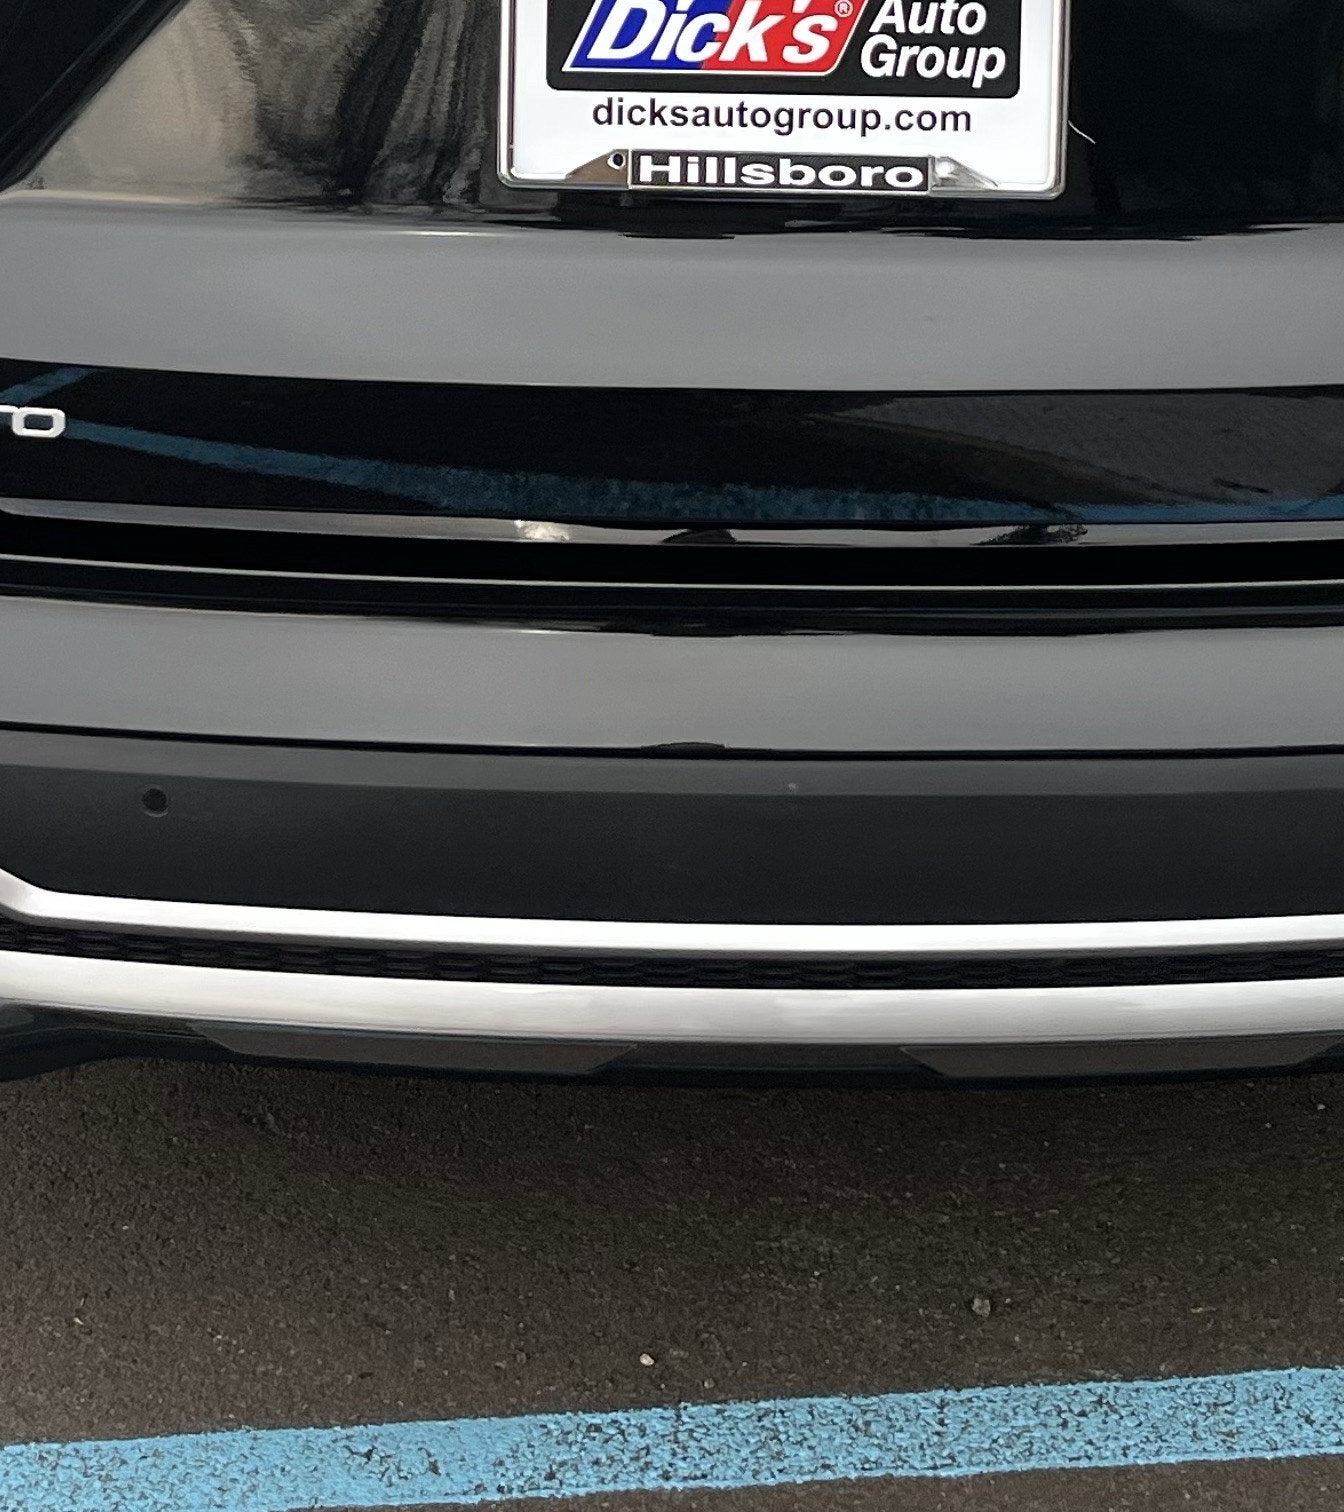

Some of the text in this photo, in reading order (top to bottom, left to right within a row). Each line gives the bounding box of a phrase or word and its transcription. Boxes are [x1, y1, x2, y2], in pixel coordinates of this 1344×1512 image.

[860, 34, 1006, 88] Group
[592, 97, 972, 137] dicksautogroup.com
[638, 155, 924, 188] Hillsboro
